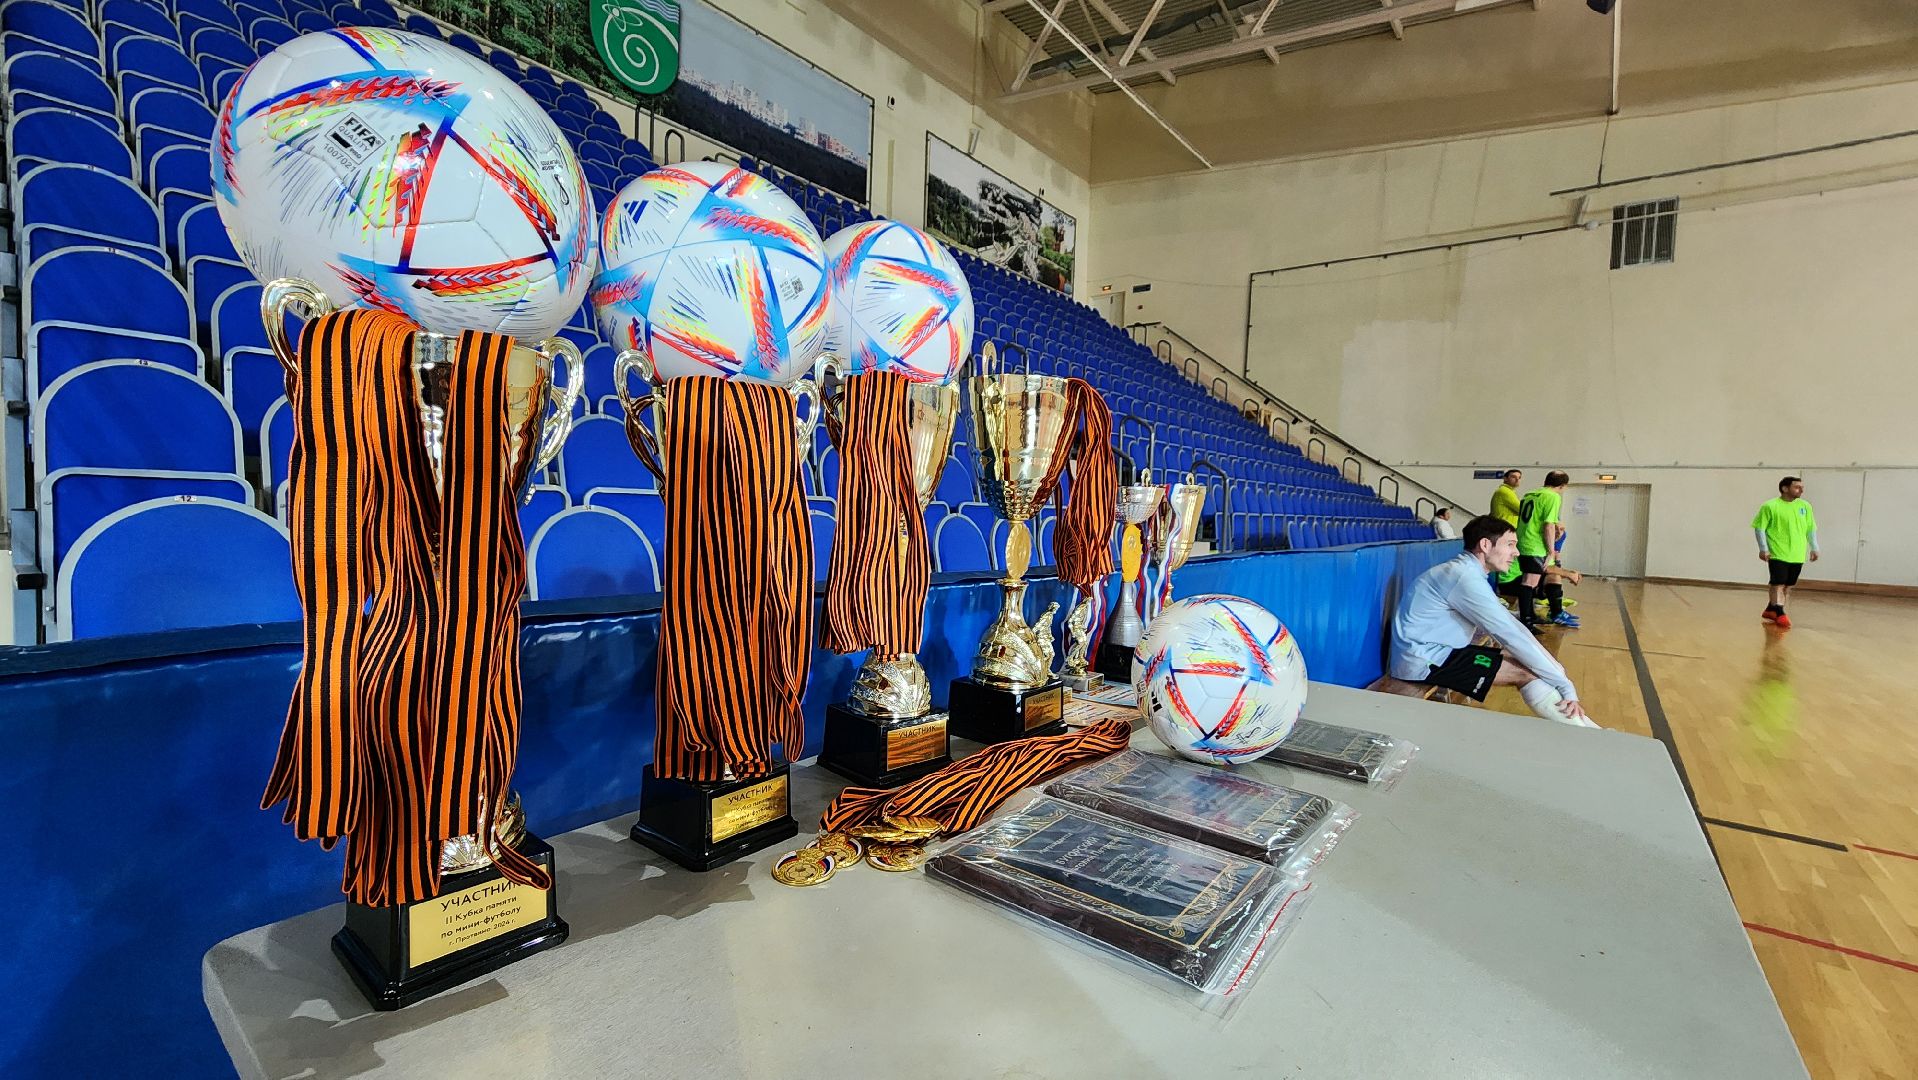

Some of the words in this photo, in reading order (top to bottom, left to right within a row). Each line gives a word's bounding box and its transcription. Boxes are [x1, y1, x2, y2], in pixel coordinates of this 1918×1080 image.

[338, 125, 370, 152] QUALITY
[344, 117, 376, 147] FIFA
[180, 495, 192, 503] 12
[898, 725, 936, 739] УЧАСТНИК
[727, 783, 773, 806] УЧАСТНИК
[1055, 833, 1100, 865] БУГОРСКИЙ
[455, 907, 484, 922] Кубка
[485, 896, 517, 912] памяти
[441, 930, 453, 939] по
[455, 906, 521, 934] мини-футболу
[455, 927, 491, 943] Протвино
[493, 919, 510, 930] 2024
